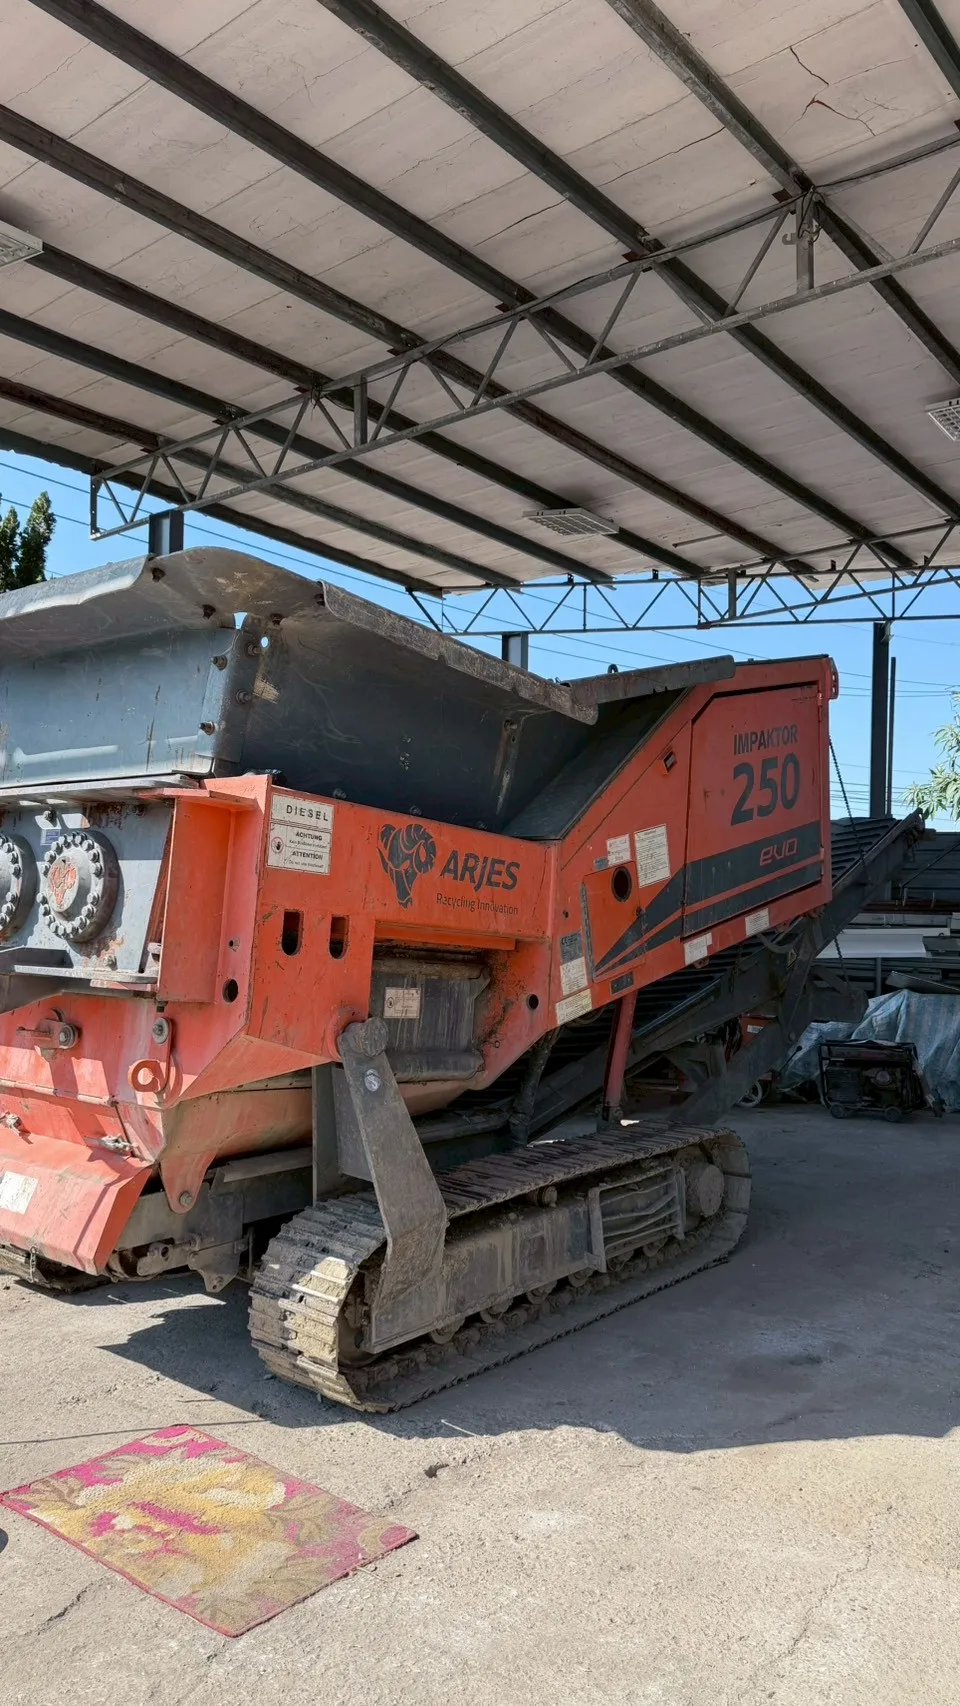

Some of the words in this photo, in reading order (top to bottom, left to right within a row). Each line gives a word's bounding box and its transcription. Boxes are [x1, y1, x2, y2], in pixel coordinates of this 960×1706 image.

[734, 724, 798, 755] IMPAKTOR
[730, 752, 800, 826] 250
[286, 804, 328, 821] DIESEL
[295, 831, 323, 841] ACHTUNG
[291, 850, 323, 860] ATTENTION
[440, 850, 520, 892] ARJES
[436, 893, 475, 911] Recycling
[477, 899, 519, 915] Innovation
